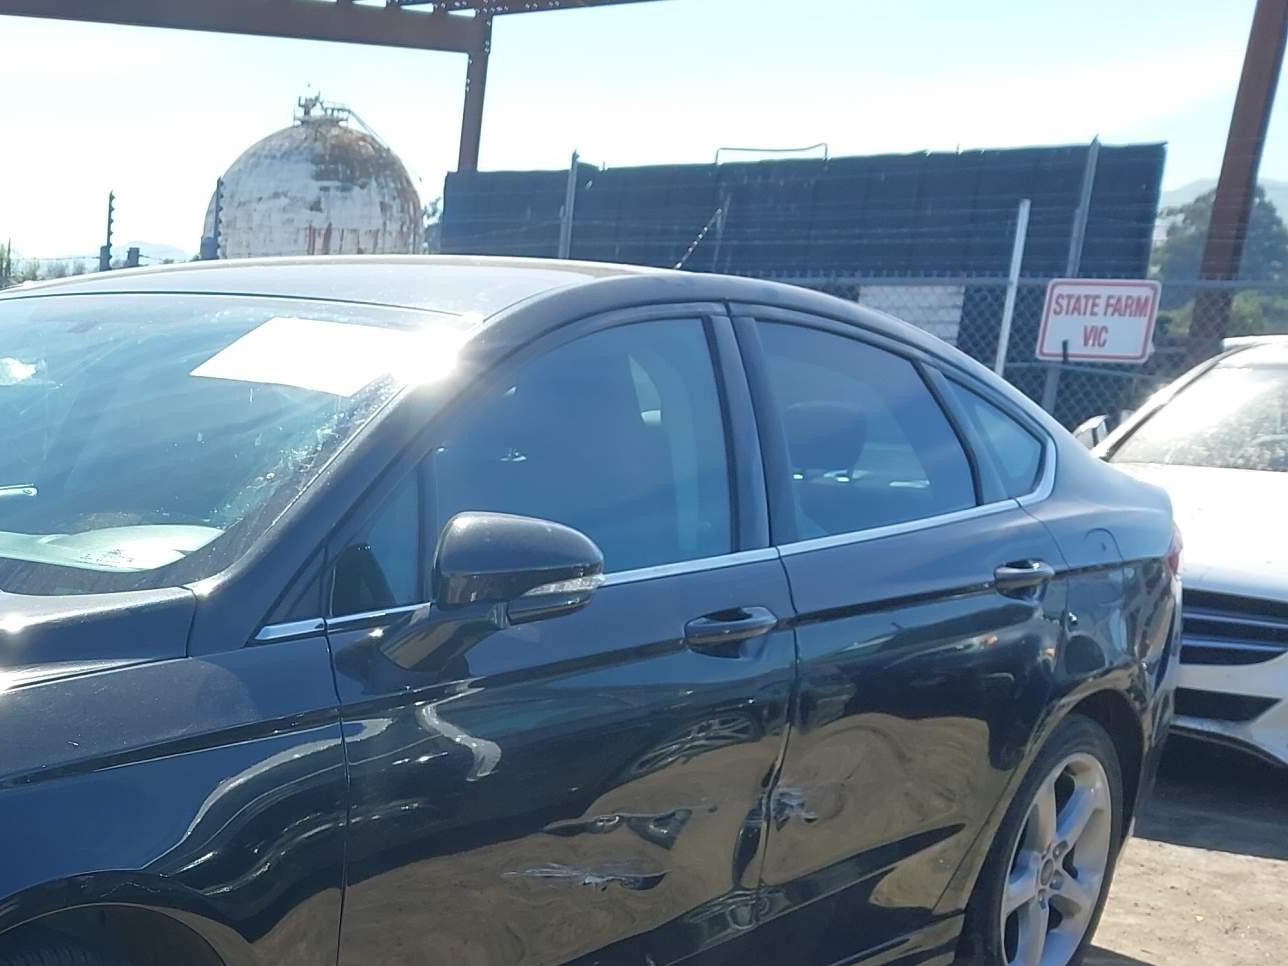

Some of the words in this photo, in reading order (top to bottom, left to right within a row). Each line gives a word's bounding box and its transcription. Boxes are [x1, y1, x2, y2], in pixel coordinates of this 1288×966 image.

[1053, 293, 1101, 316] STATE
[1103, 294, 1150, 318] FARM
[1083, 325, 1108, 347] VIC
